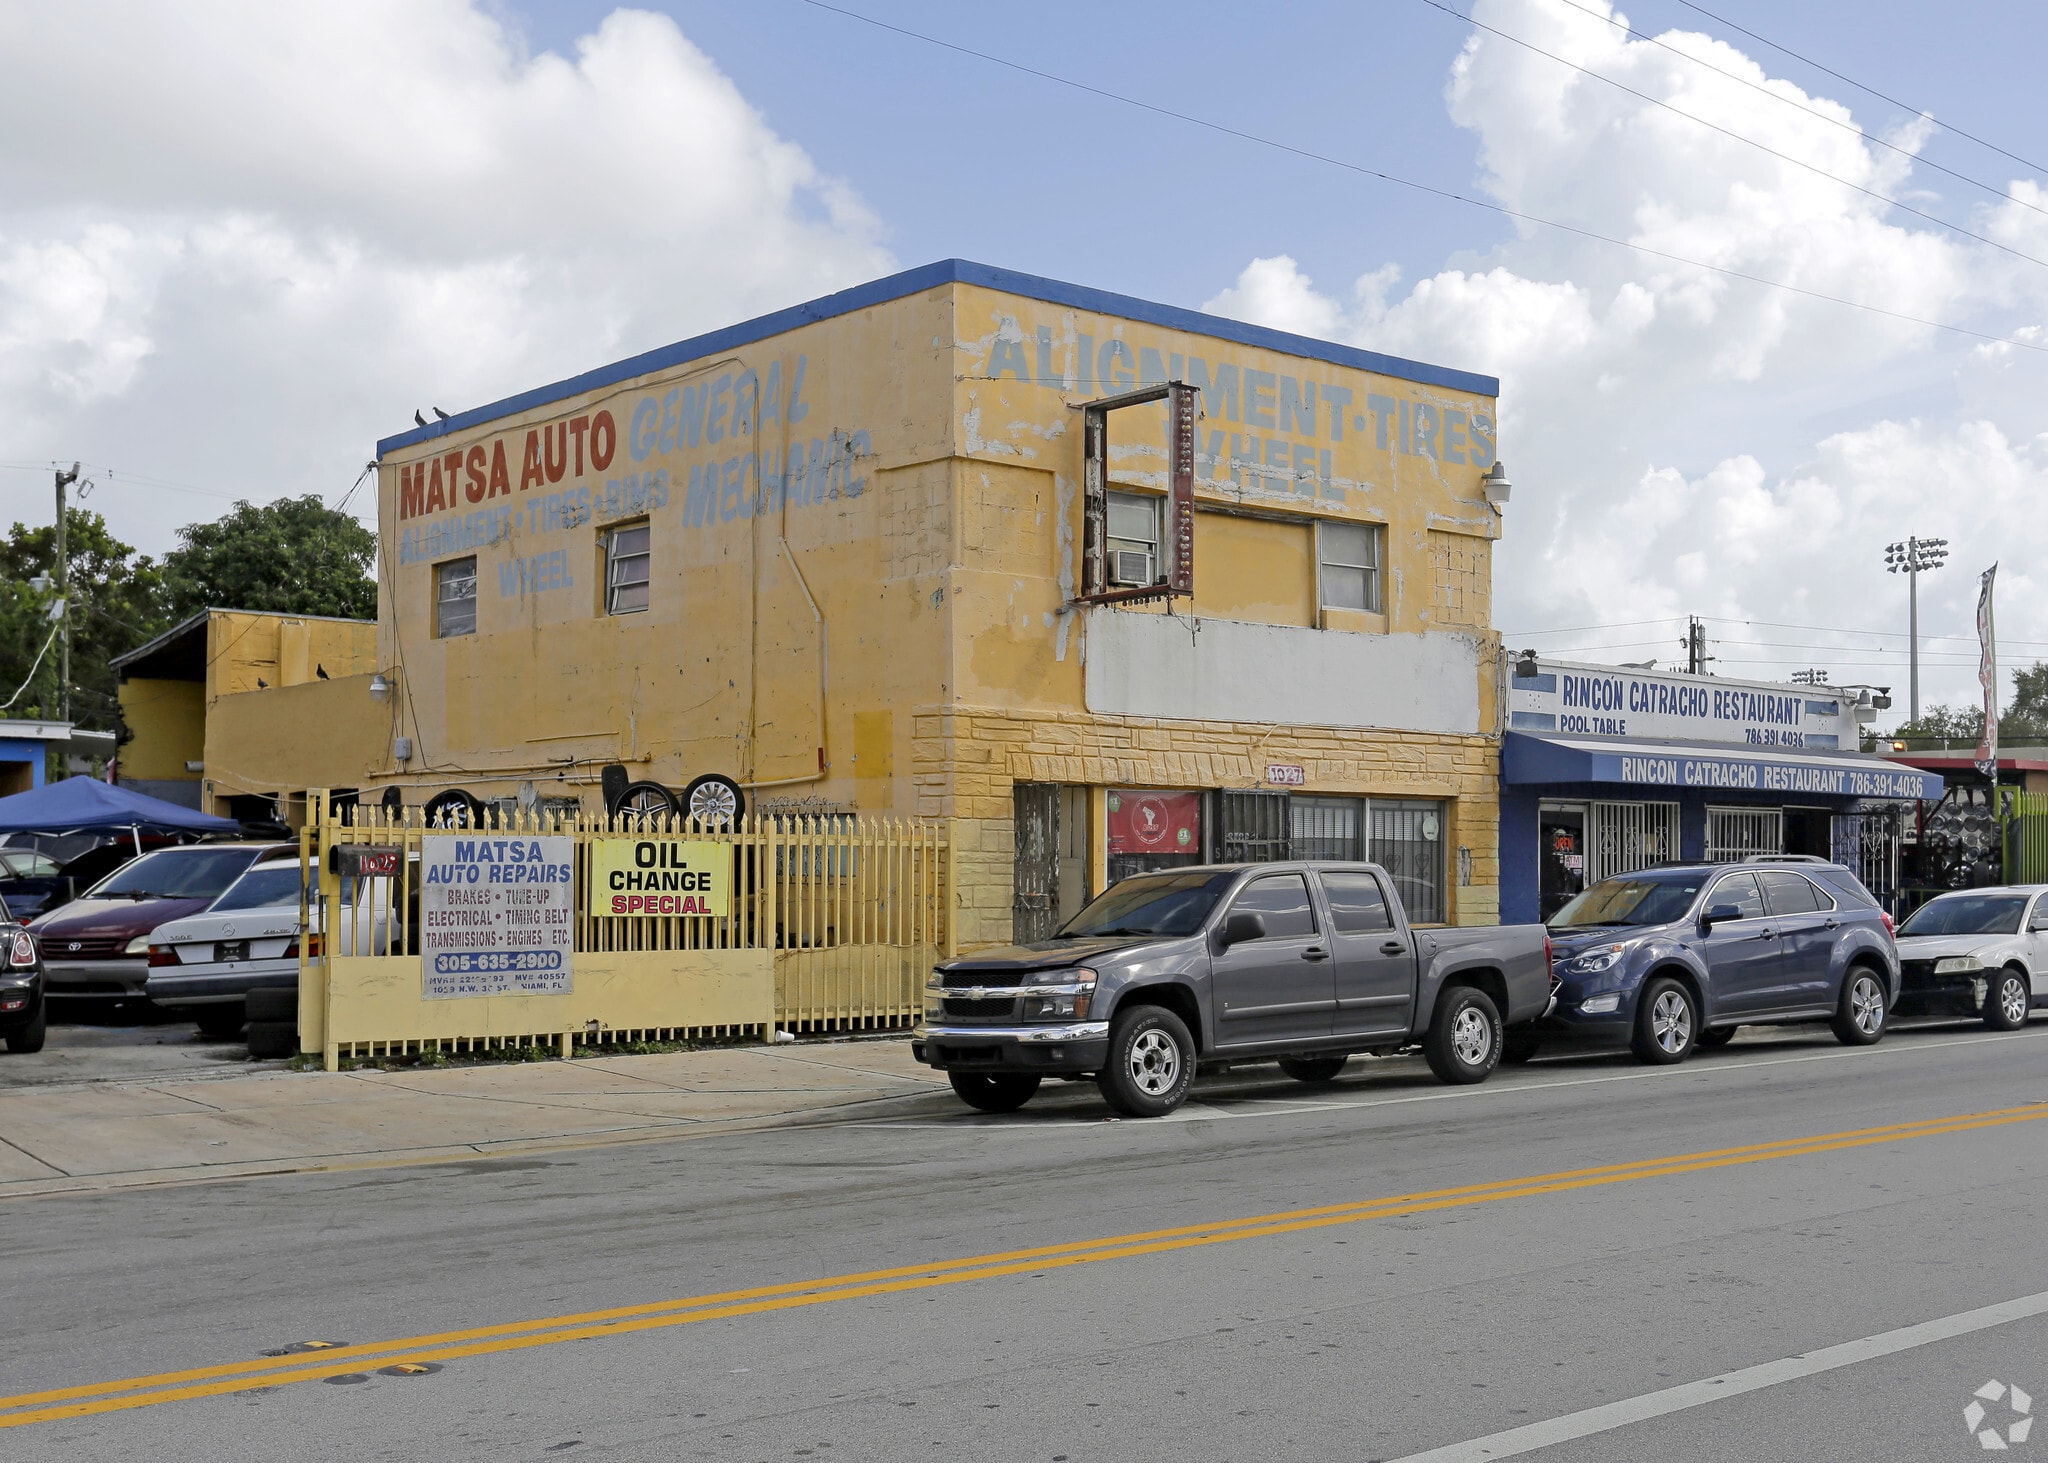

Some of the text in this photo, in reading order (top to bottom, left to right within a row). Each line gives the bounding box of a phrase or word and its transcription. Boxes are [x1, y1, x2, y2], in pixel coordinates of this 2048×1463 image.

[986, 325, 1495, 468] ALIGNMENT TIRES
[629, 354, 809, 463] GENERAL
[400, 410, 617, 520] MATSA AUTO
[682, 428, 871, 529] MECHANIC
[400, 467, 669, 566] ALIGNMENT TIRES RIMS
[498, 549, 574, 598] WHEEL
[1629, 681, 1708, 718] CATRACHO
[1713, 690, 1802, 726] RESTAURANT
[1560, 714, 1626, 736] POOL TABLE
[1745, 728, 1804, 748] 786 391 4036
[1271, 767, 1301, 782] 1027
[1621, 757, 1923, 798] RINCON CATRACHO RESTAURANT 786-391-4036
[455, 841, 544, 863] MATSA
[635, 842, 687, 868] OIL
[360, 852, 399, 875] 1029
[426, 864, 571, 884] AUTO REPAIRS
[609, 871, 711, 891] CHANGE
[448, 889, 550, 905] BRAKES TUNE-UP
[611, 895, 712, 914] SPECIAL
[428, 908, 569, 927] ELECTRICAL TIMING BELT
[426, 929, 570, 948] TRANSMISSIONS ENGINES ETC.
[437, 953, 559, 971] 305-635-2900
